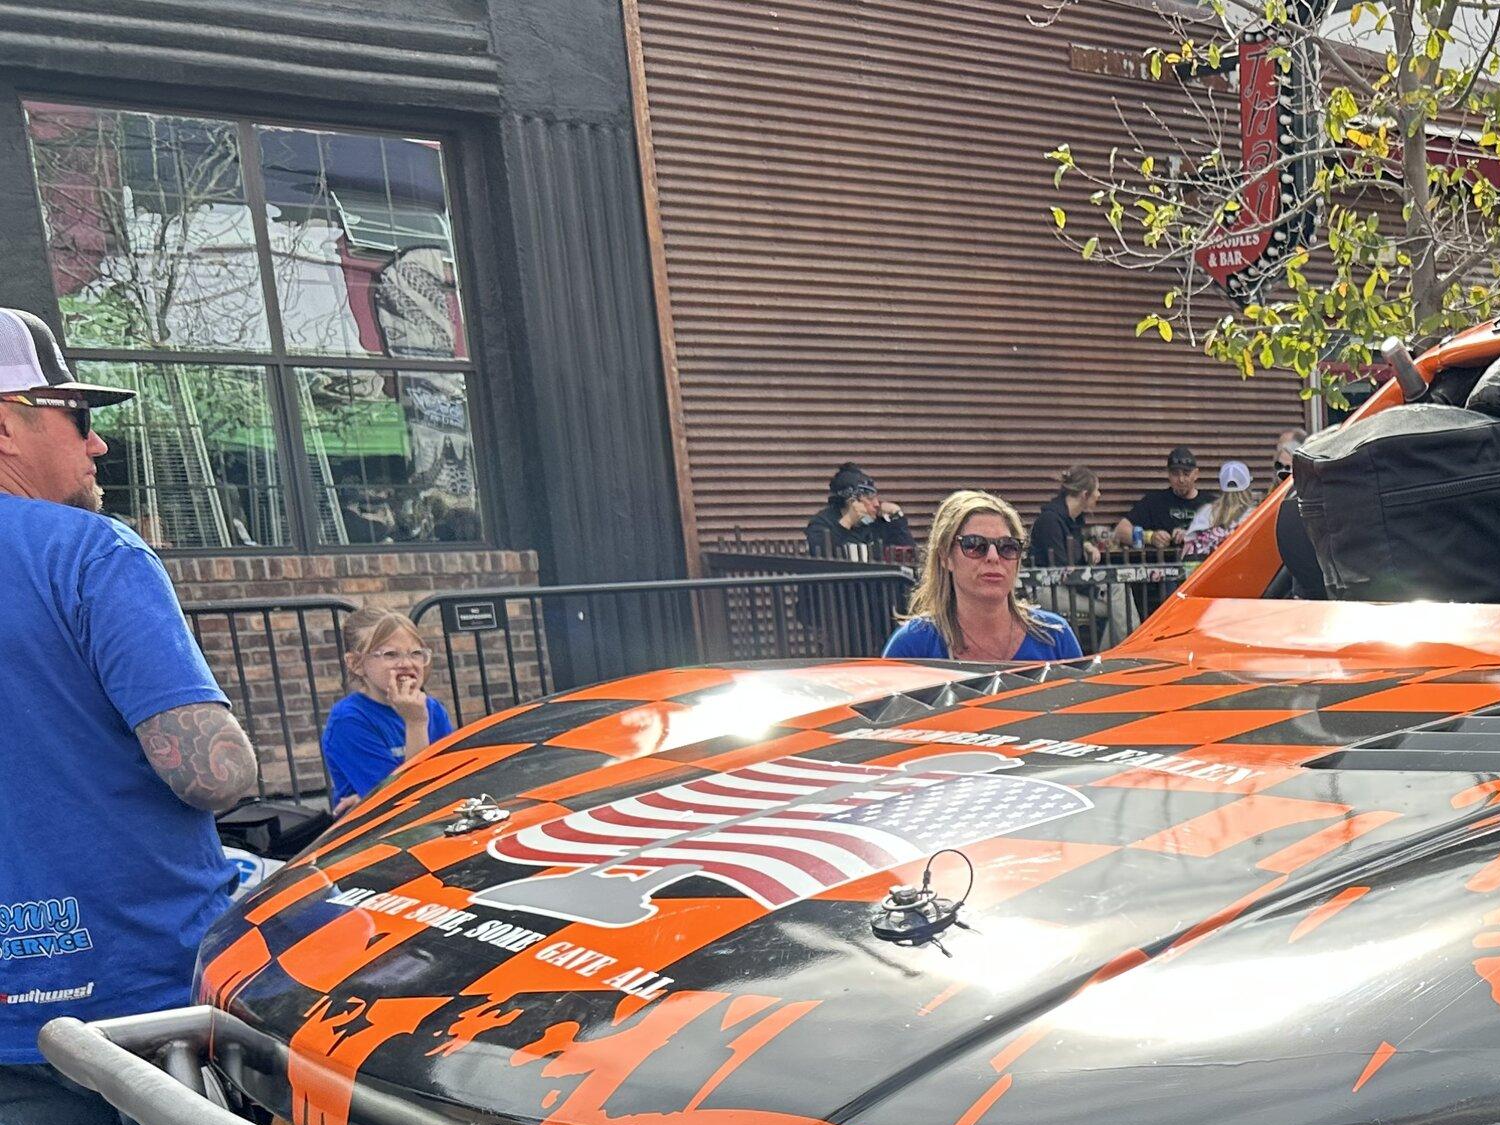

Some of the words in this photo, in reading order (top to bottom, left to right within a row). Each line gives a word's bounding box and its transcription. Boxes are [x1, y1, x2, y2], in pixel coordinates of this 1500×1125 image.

[1208, 253, 1218, 268] &
[1219, 250, 1242, 266] BAR
[1016, 738, 1109, 758] THE
[1095, 748, 1267, 785] FALLEN
[325, 887, 377, 907] ALL
[358, 892, 421, 916] GAVE
[402, 903, 478, 938] SOME,
[462, 919, 547, 953] SOME
[534, 940, 619, 978] GAVE
[601, 966, 675, 1001] ALL
